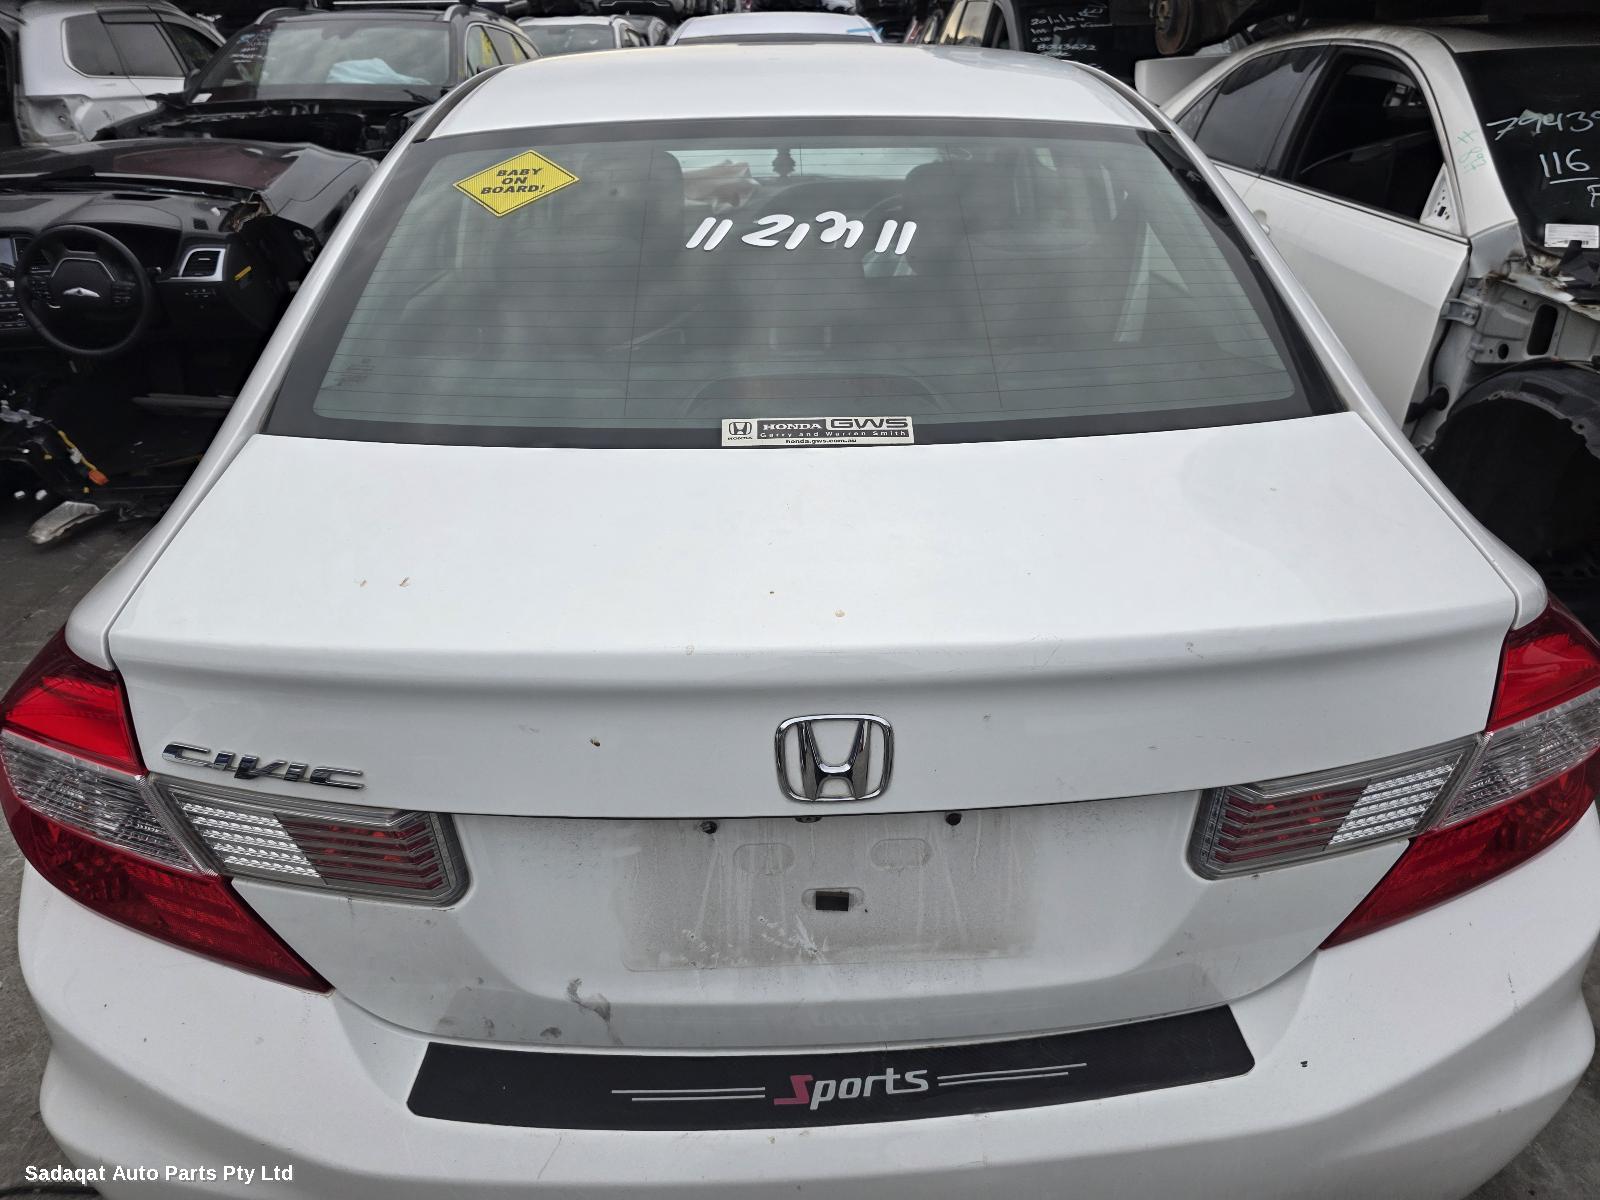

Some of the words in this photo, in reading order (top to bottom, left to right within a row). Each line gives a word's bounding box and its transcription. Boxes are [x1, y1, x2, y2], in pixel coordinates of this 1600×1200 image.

[1539, 148, 1591, 178] 116
[496, 168, 543, 176] BABY
[501, 177, 528, 185] ON
[480, 185, 545, 194] BOARD!
[831, 418, 909, 429] GWS
[162, 742, 364, 789] CIVIC
[774, 1068, 929, 1110] Sports
